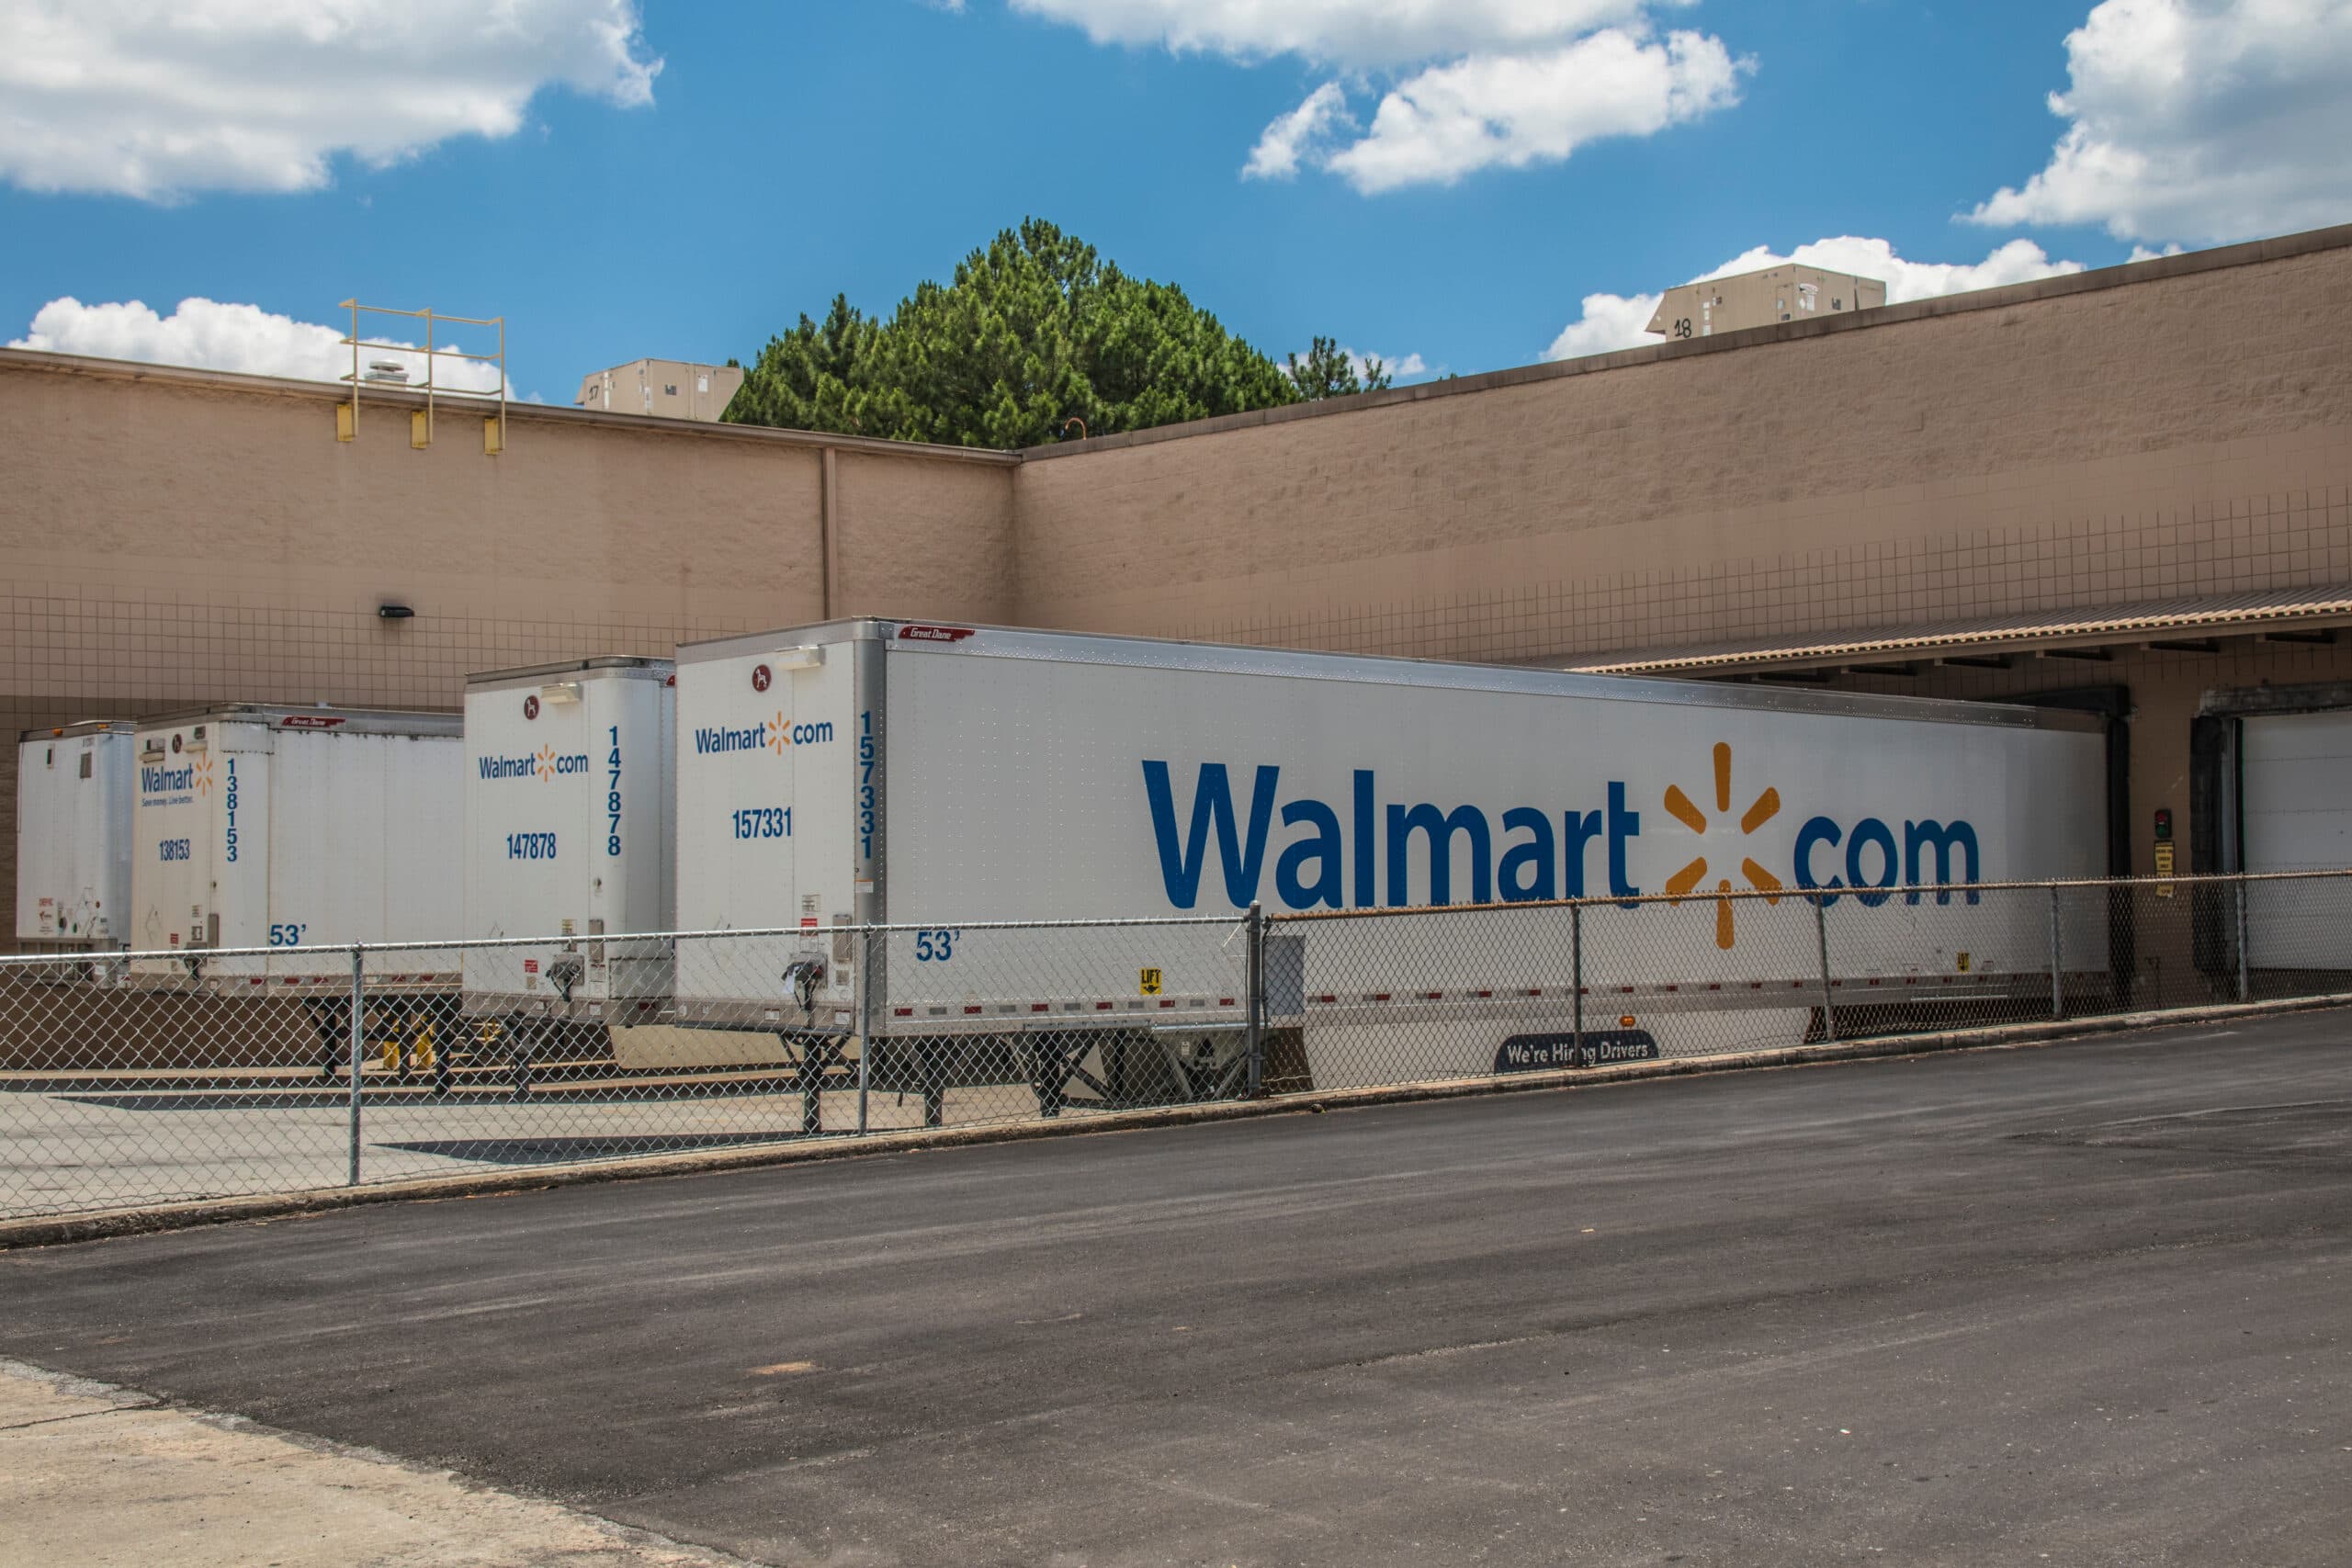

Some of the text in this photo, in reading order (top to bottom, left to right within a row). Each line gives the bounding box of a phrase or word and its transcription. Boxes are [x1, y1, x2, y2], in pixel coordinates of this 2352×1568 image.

[1674, 318, 1691, 338] 18
[910, 627, 952, 640] Great Dane
[695, 721, 833, 754] Walmart com
[141, 762, 193, 794] Walmart
[479, 752, 588, 780] Walmart com
[607, 726, 621, 856] 147878
[860, 710, 875, 860] 157331
[226, 758, 238, 863] 138153
[732, 807, 792, 840] 157331
[506, 832, 557, 860] 147878
[1141, 759, 1981, 910] Walmart com
[159, 839, 190, 862] 138153
[1141, 969, 1160, 984] LIFT
[1508, 1040, 1648, 1066] We're Hirng Drivers
